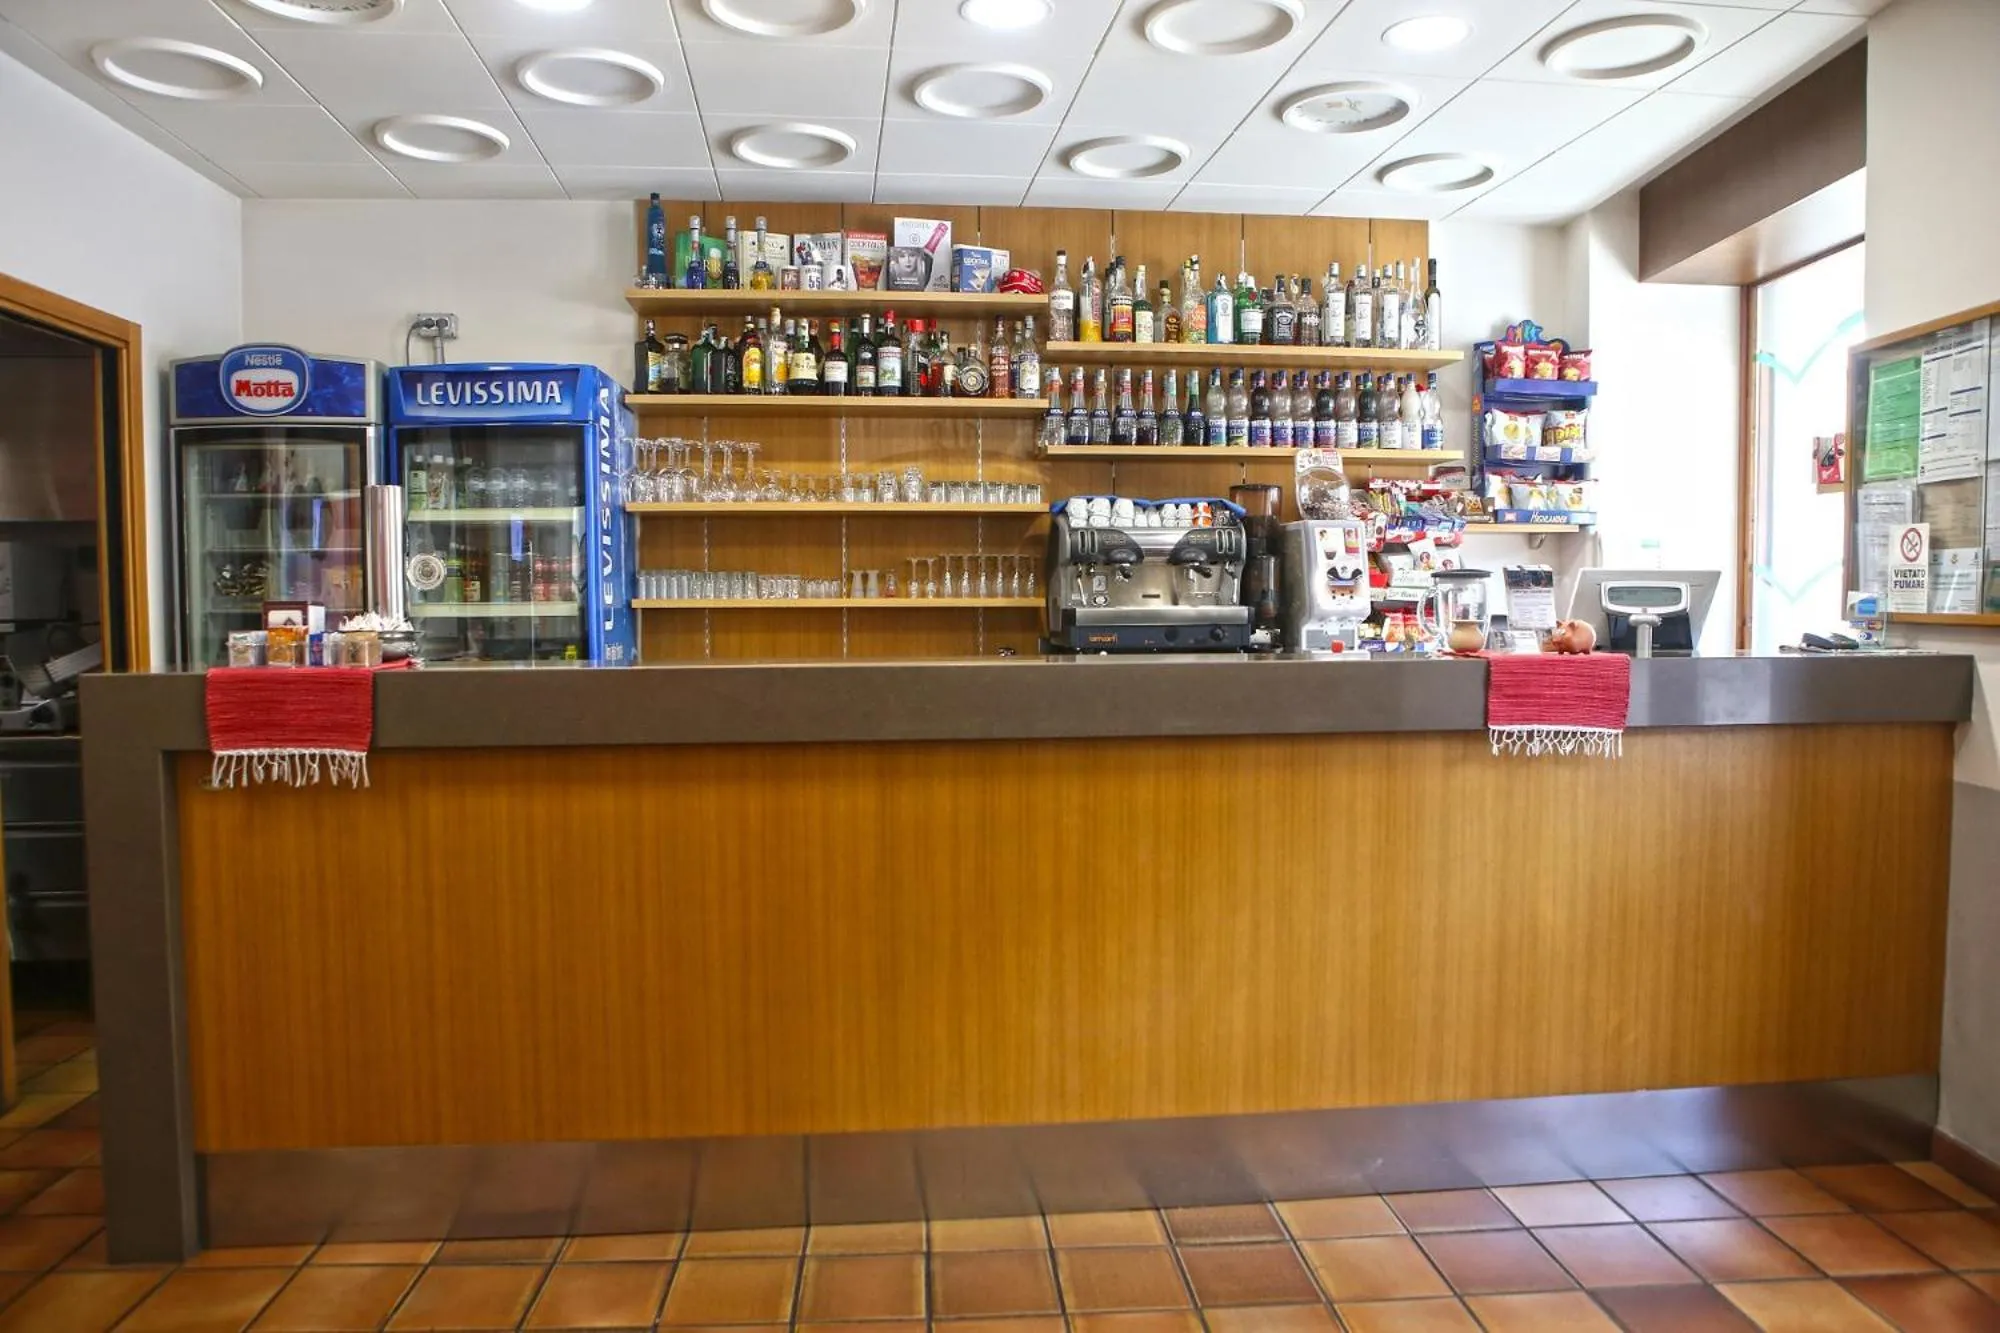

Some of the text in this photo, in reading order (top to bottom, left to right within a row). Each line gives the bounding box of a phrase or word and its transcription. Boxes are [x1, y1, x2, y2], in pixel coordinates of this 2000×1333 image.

[244, 353, 283, 366] Nestlé
[234, 379, 295, 398] Motta
[416, 381, 562, 405] LEVISSIMA
[599, 386, 616, 631] LEVISSIMA
[1893, 568, 1926, 579] VIETATO
[1893, 579, 1925, 590] FUMARE
